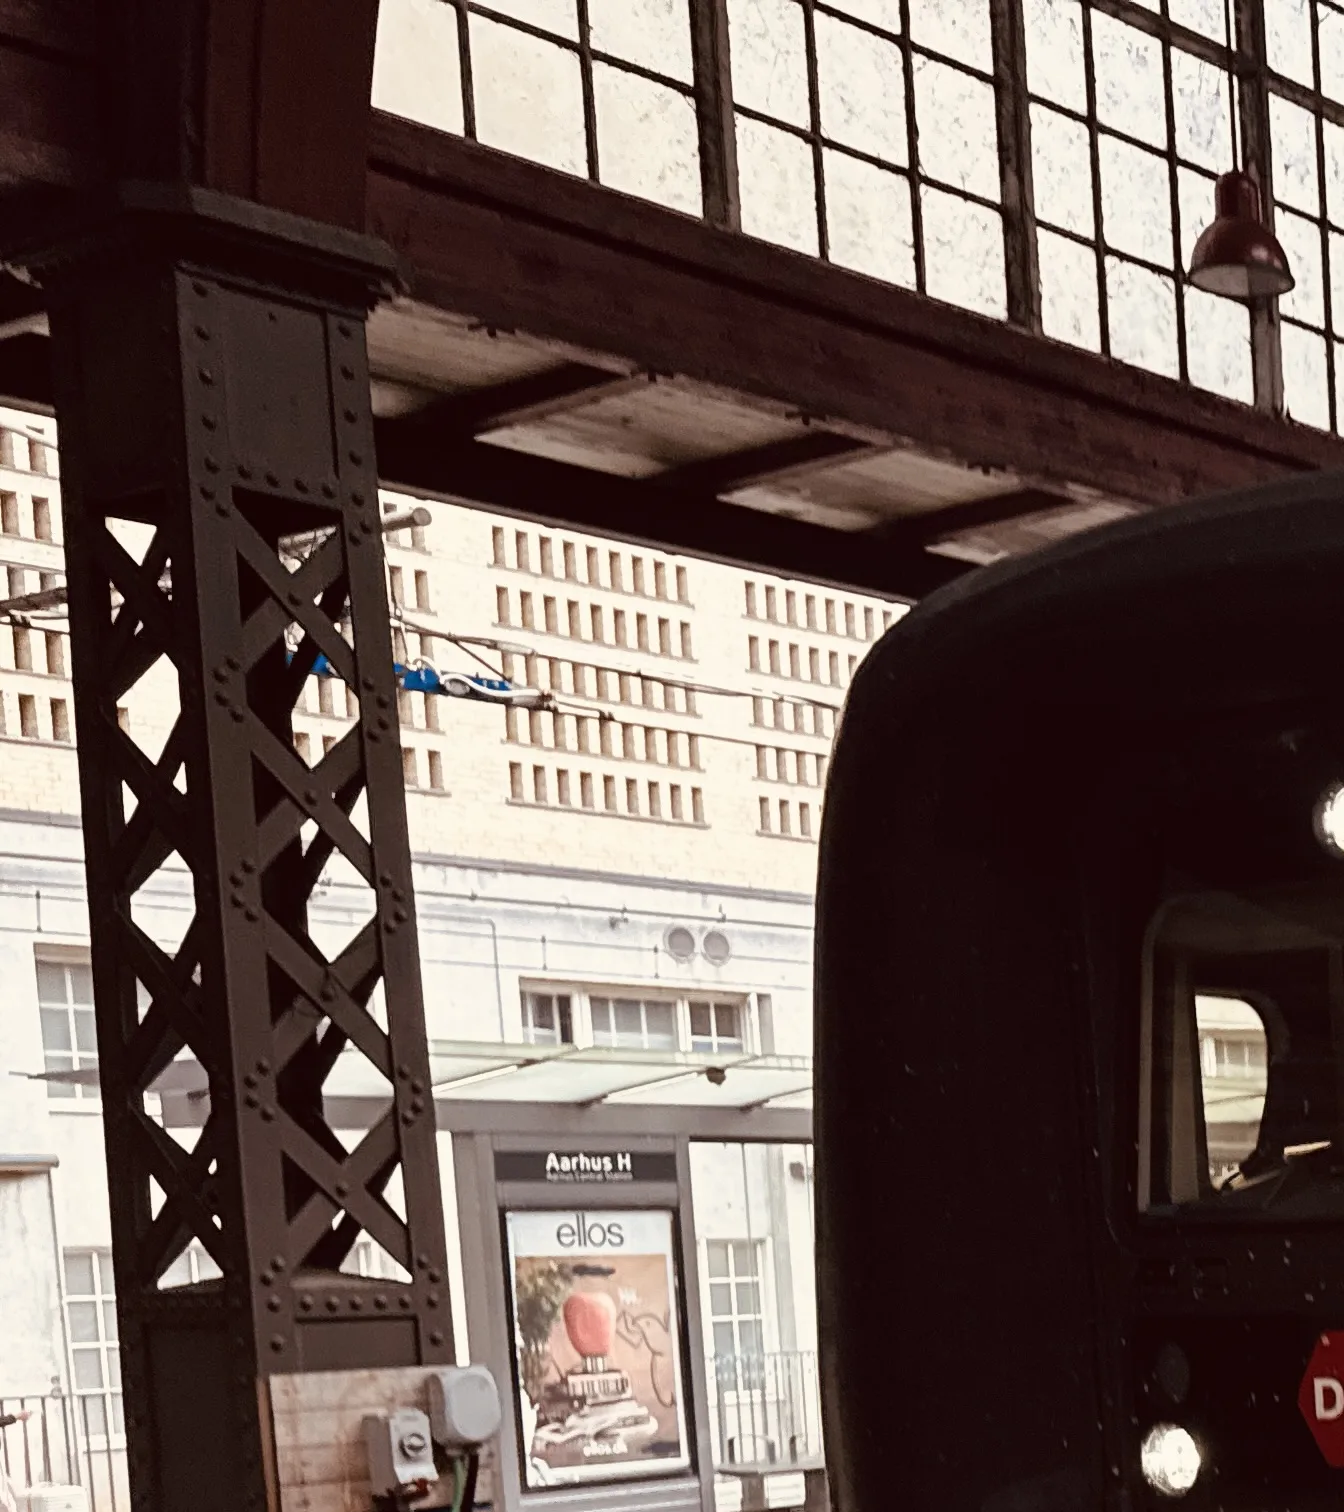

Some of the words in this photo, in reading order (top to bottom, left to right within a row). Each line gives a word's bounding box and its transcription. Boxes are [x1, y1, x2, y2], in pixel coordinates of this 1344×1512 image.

[546, 1152, 613, 1172] Aarhus
[617, 1152, 632, 1172] H
[556, 1213, 625, 1248] ellos
